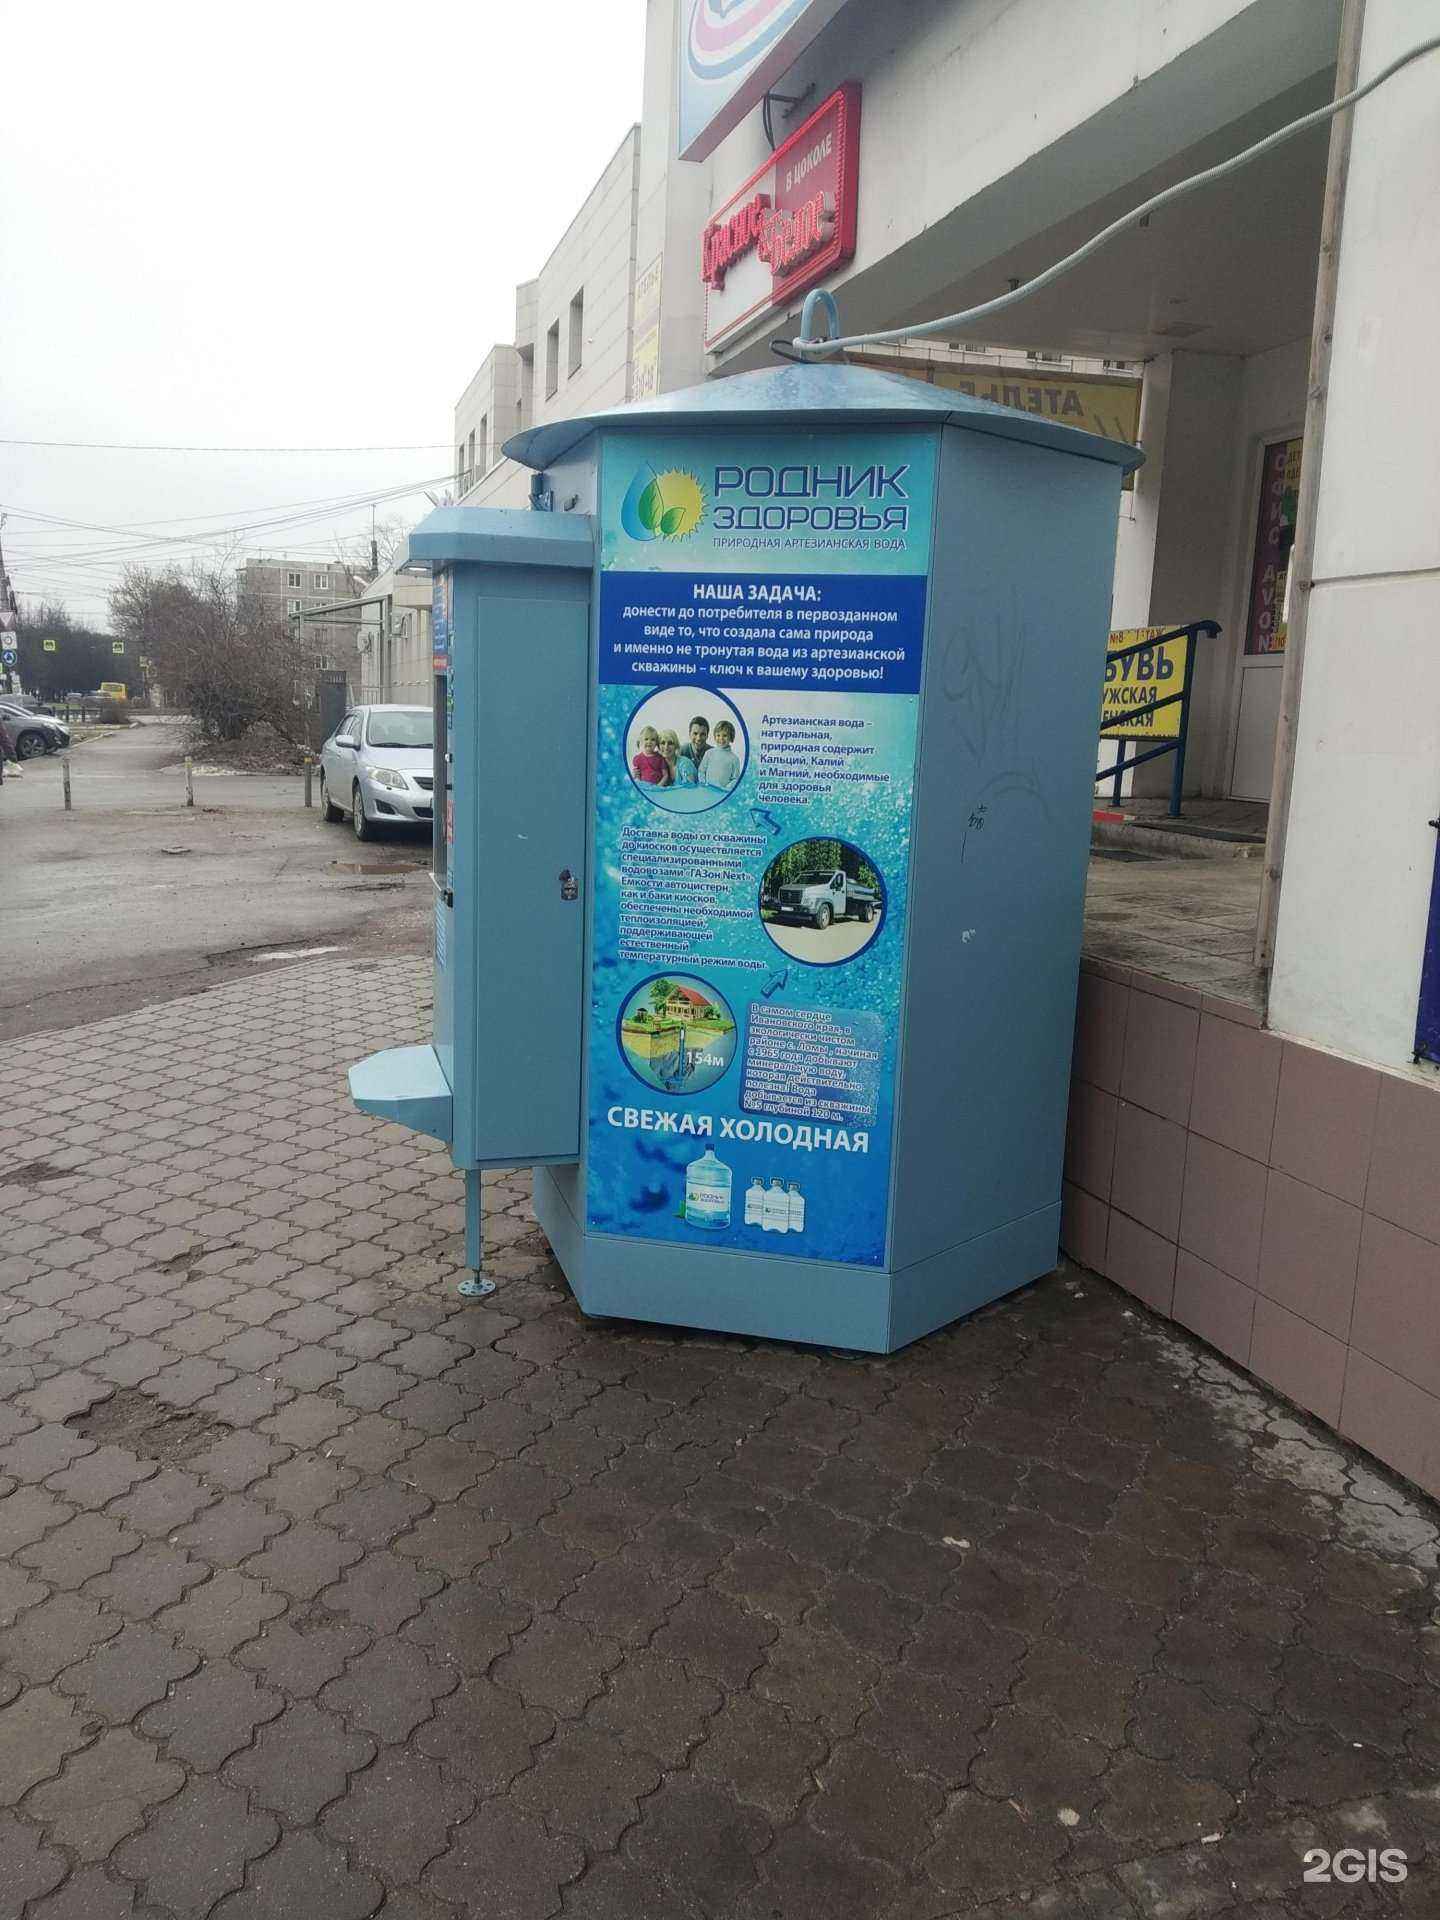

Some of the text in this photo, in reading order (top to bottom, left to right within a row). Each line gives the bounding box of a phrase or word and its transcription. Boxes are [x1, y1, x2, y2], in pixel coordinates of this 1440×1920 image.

[786, 133, 833, 192] В ЦОКОЛЕ
[713, 463, 909, 499] РОДНИК
[713, 505, 908, 531] ЗДОРОВЬЯ
[713, 537, 906, 550] ПРИРОДНАЯ АРТЕЗИАНСКАЯ ВОДА
[693, 584, 822, 603] НАША ЗАДАЧА:
[623, 605, 898, 624] донести до потребителя в первозданном
[1257, 564, 1275, 653] AVON
[644, 624, 873, 643] виде то, что создала сама природа
[614, 644, 905, 663] и именно не тронутая вода из артезианской
[632, 662, 696, 674] скважины
[709, 664, 744, 676] ключ
[746, 666, 754, 675] к
[757, 666, 808, 680] вашему
[811, 666, 884, 680] здоровью!
[762, 714, 836, 727] Артезианская
[839, 718, 864, 728] вода
[761, 730, 832, 740] натуральная,
[761, 743, 875, 755] природная содержит
[760, 754, 844, 766] Кальций, Калий
[814, 771, 890, 782] необходимые
[759, 781, 832, 793] для здоровья
[759, 794, 810, 804] человека.
[623, 827, 669, 839] Доставка
[671, 832, 698, 841] воды
[713, 835, 766, 844] скважины
[622, 842, 761, 857] до киосков осуществляется
[622, 854, 741, 868] специализированными
[622, 866, 683, 877] водовозами
[621, 891, 638, 899] как
[648, 891, 673, 900] баки
[621, 903, 753, 918] обеспечены необходимой
[620, 915, 707, 928] теплоизоляцией,
[620, 929, 712, 941] поддерживающей
[620, 940, 689, 950] естественный
[620, 952, 699, 964] температурный
[701, 956, 736, 967] режим
[752, 1003, 832, 1021] В самом сердце
[751, 1015, 814, 1029] Ивановского
[749, 1037, 785, 1048] районе
[750, 1027, 855, 1046] экологически чистом
[687, 1052, 724, 1066] 154м
[756, 1047, 779, 1057] 1965
[781, 1052, 803, 1062] года
[805, 1055, 858, 1068] добывают
[747, 1069, 785, 1080] которая
[792, 1086, 817, 1097] Вода
[805, 1098, 817, 1106] из
[763, 1103, 811, 1116] глубиной
[608, 1106, 869, 1153] СВЕЖАЯ ХОЛОДНАЯ
